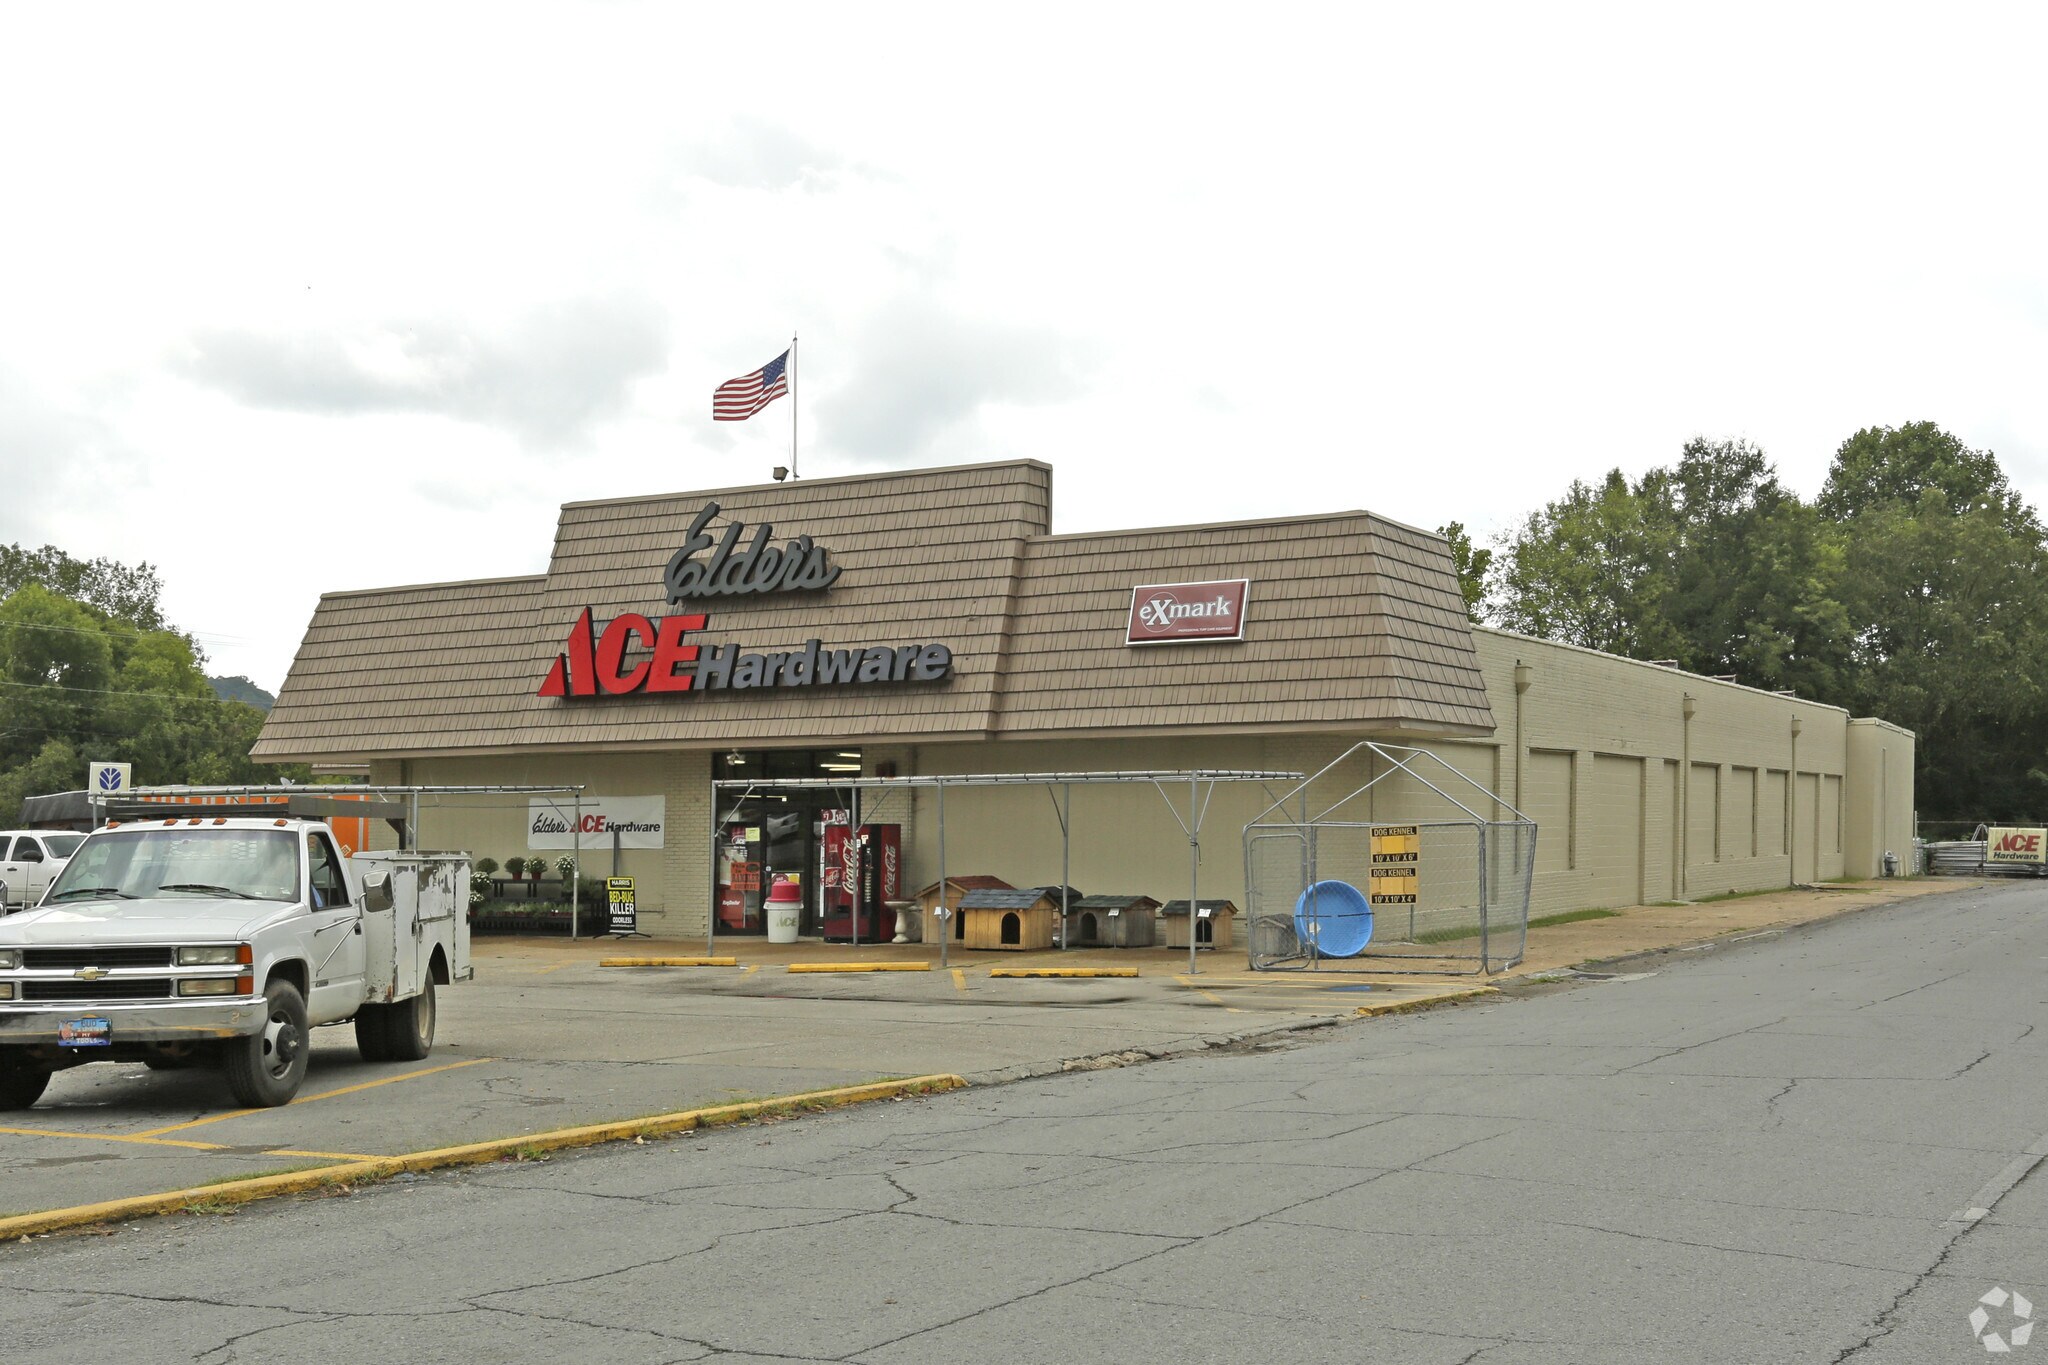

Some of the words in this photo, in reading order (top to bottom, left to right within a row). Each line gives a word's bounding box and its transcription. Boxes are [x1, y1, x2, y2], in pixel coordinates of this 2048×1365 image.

[663, 501, 843, 605] Elder's
[537, 605, 709, 697] ACE
[694, 639, 953, 690] Hardware
[532, 812, 568, 835] Elder's
[569, 812, 606, 833] ACE
[605, 821, 661, 832] Hardware
[1374, 828, 1387, 836] DOG
[1389, 827, 1415, 835] KENNEL
[1993, 832, 2041, 852] ACE
[1993, 851, 2039, 860] Hardware
[1373, 869, 1387, 877] DOG
[609, 891, 634, 903] BED-BUG
[610, 903, 635, 915] KILLER
